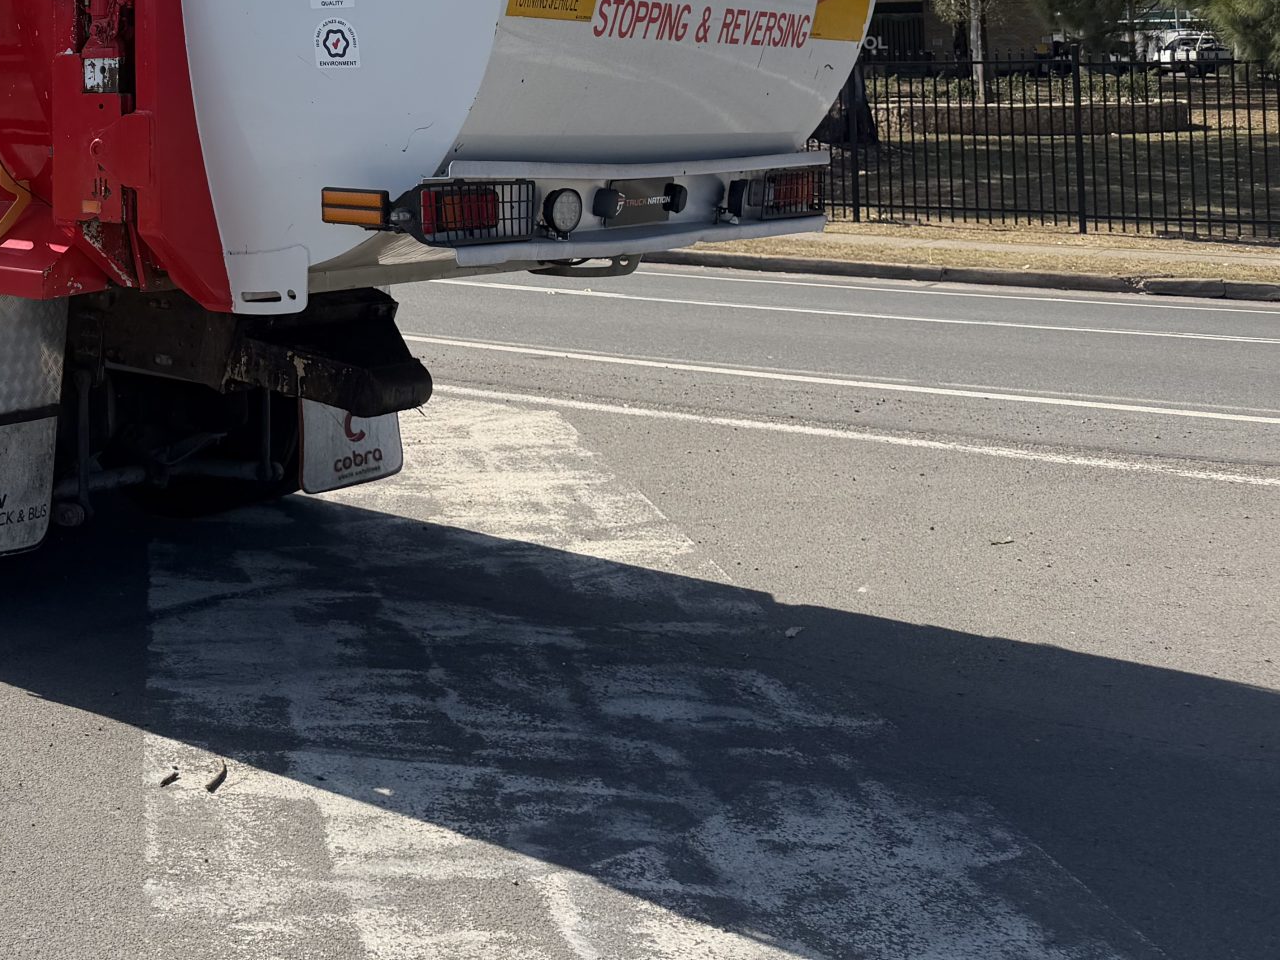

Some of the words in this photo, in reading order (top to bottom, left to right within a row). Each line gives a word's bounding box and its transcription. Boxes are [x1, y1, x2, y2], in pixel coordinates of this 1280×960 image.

[695, 11, 711, 43] &
[718, 8, 811, 49] REVERSING
[626, 198, 647, 207] TRUCK
[648, 195, 671, 205] NATION
[334, 448, 383, 472] cobra
[17, 509, 25, 522] &
[28, 504, 47, 521] BUS
